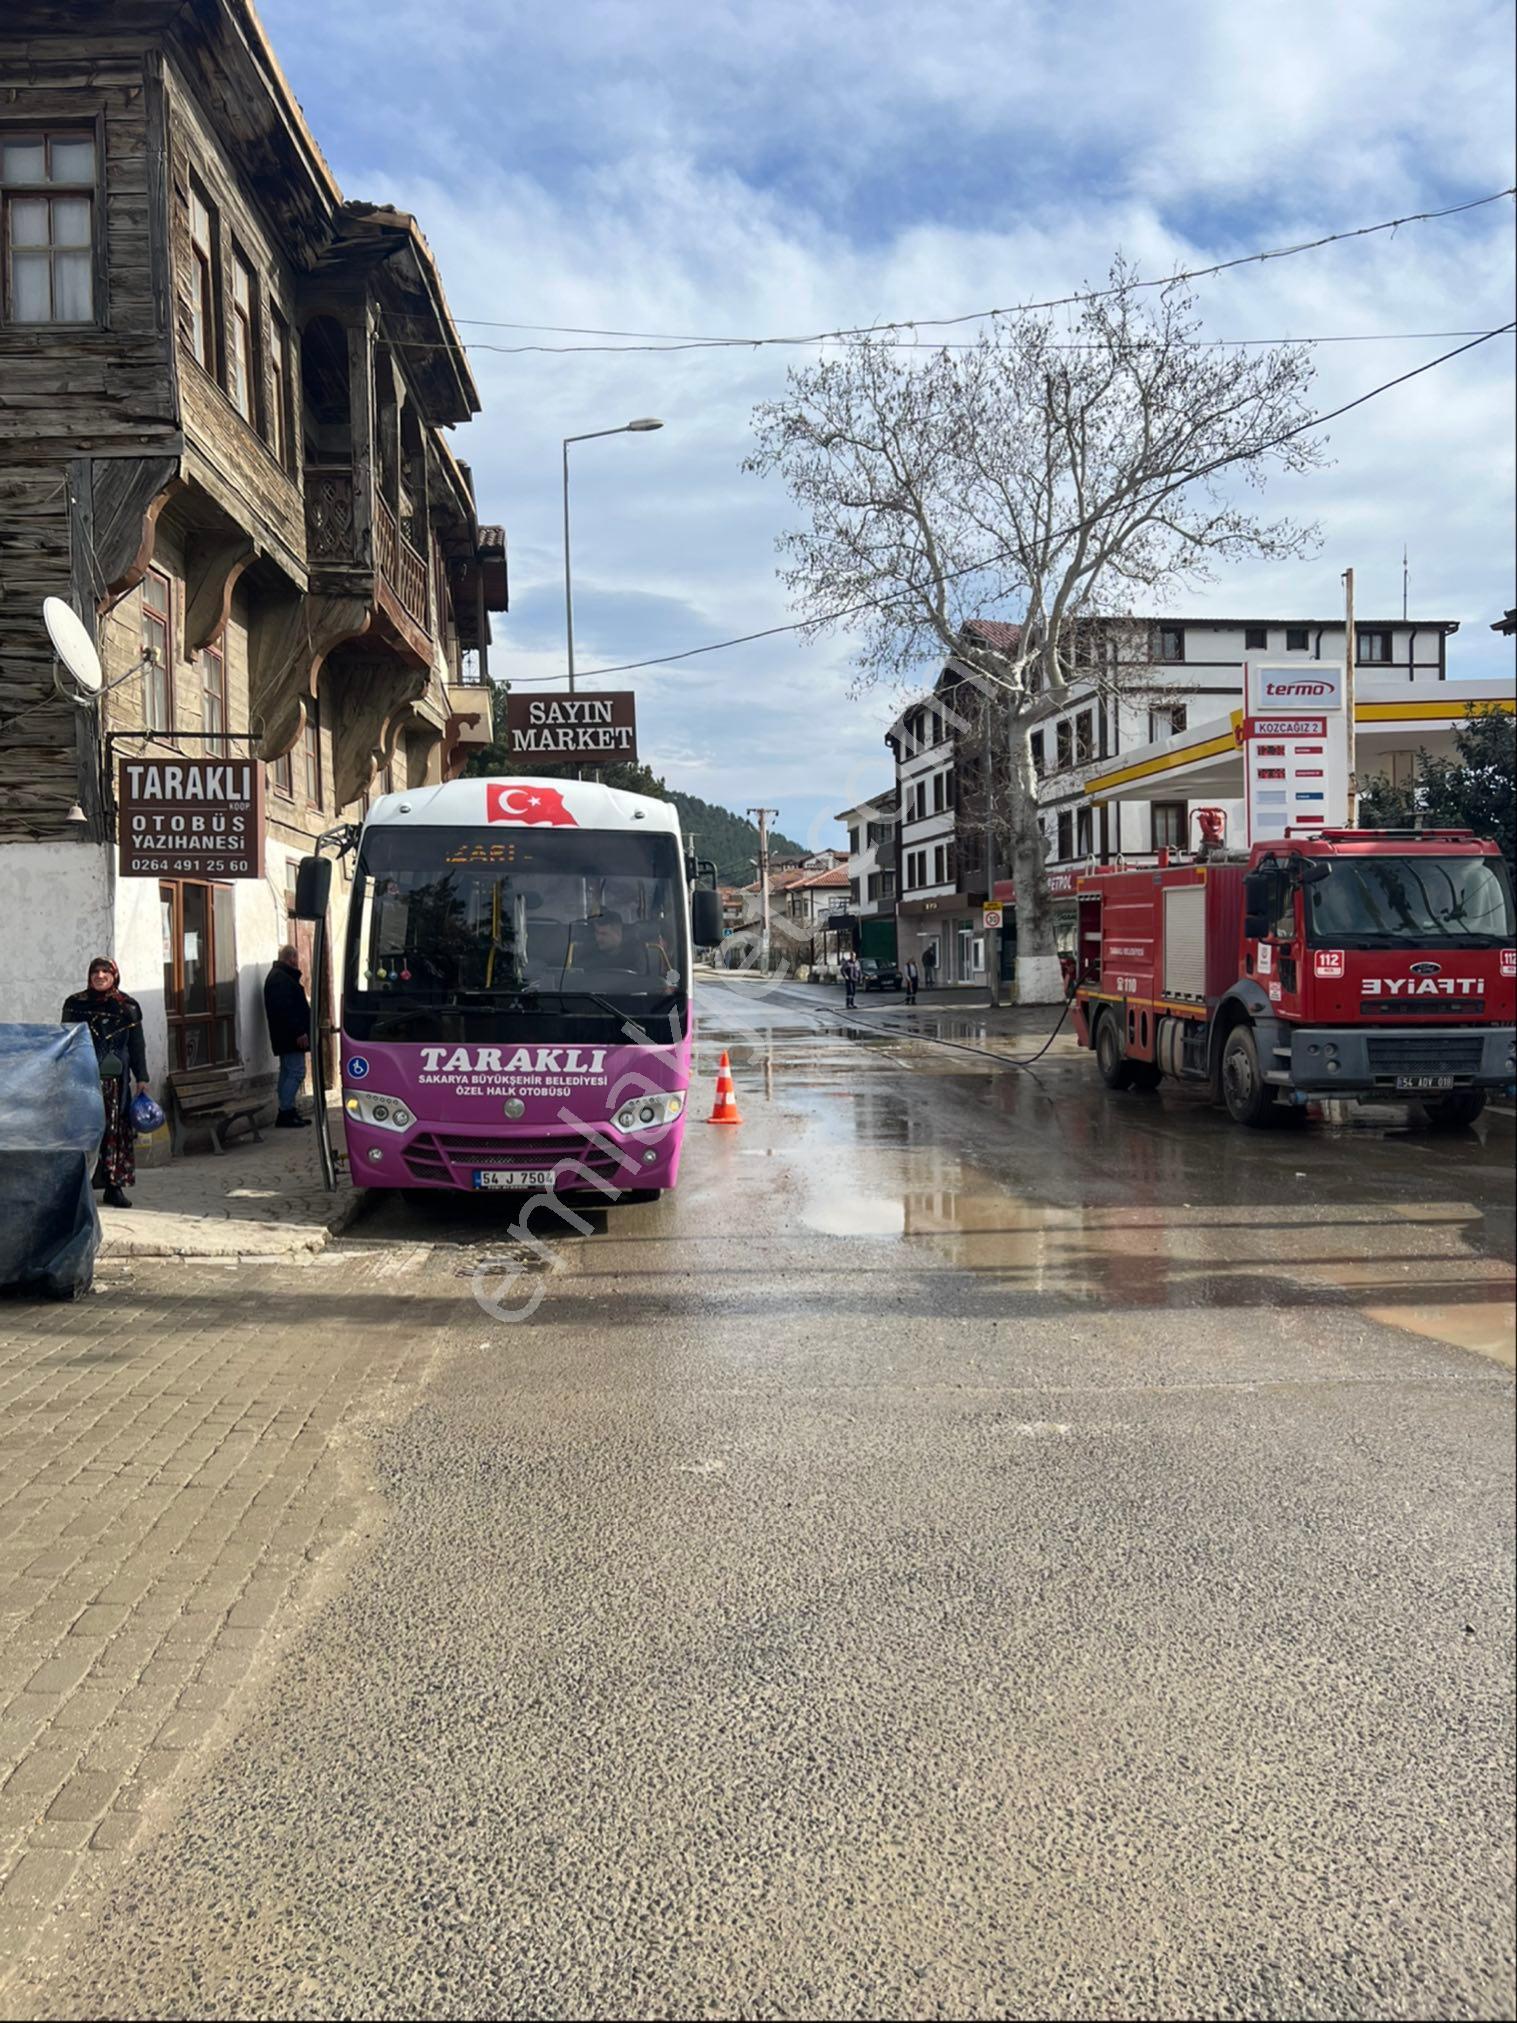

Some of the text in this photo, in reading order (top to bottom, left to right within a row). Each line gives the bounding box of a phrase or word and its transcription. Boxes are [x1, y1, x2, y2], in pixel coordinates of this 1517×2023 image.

[1266, 682, 1325, 696] termo
[529, 701, 613, 725] SAYIN
[1259, 722, 1319, 733] KOZCAĞIZ 2
[512, 727, 633, 752] MARKET
[126, 765, 251, 801] TARAKLI
[228, 802, 251, 811] KOOP
[132, 813, 246, 832] OTOBÜS
[131, 859, 249, 871] 0264 491 25 60
[1319, 954, 1340, 966] 112
[420, 1048, 607, 1073] TARAKLI
[418, 1074, 608, 1086] SAKARYA BÜYÜKŞEHİR BELEDİYESİ
[456, 1085, 571, 1097] ÖZEL HALK OTOBÜSÜ
[483, 1172, 553, 1184] 54 J 7504
